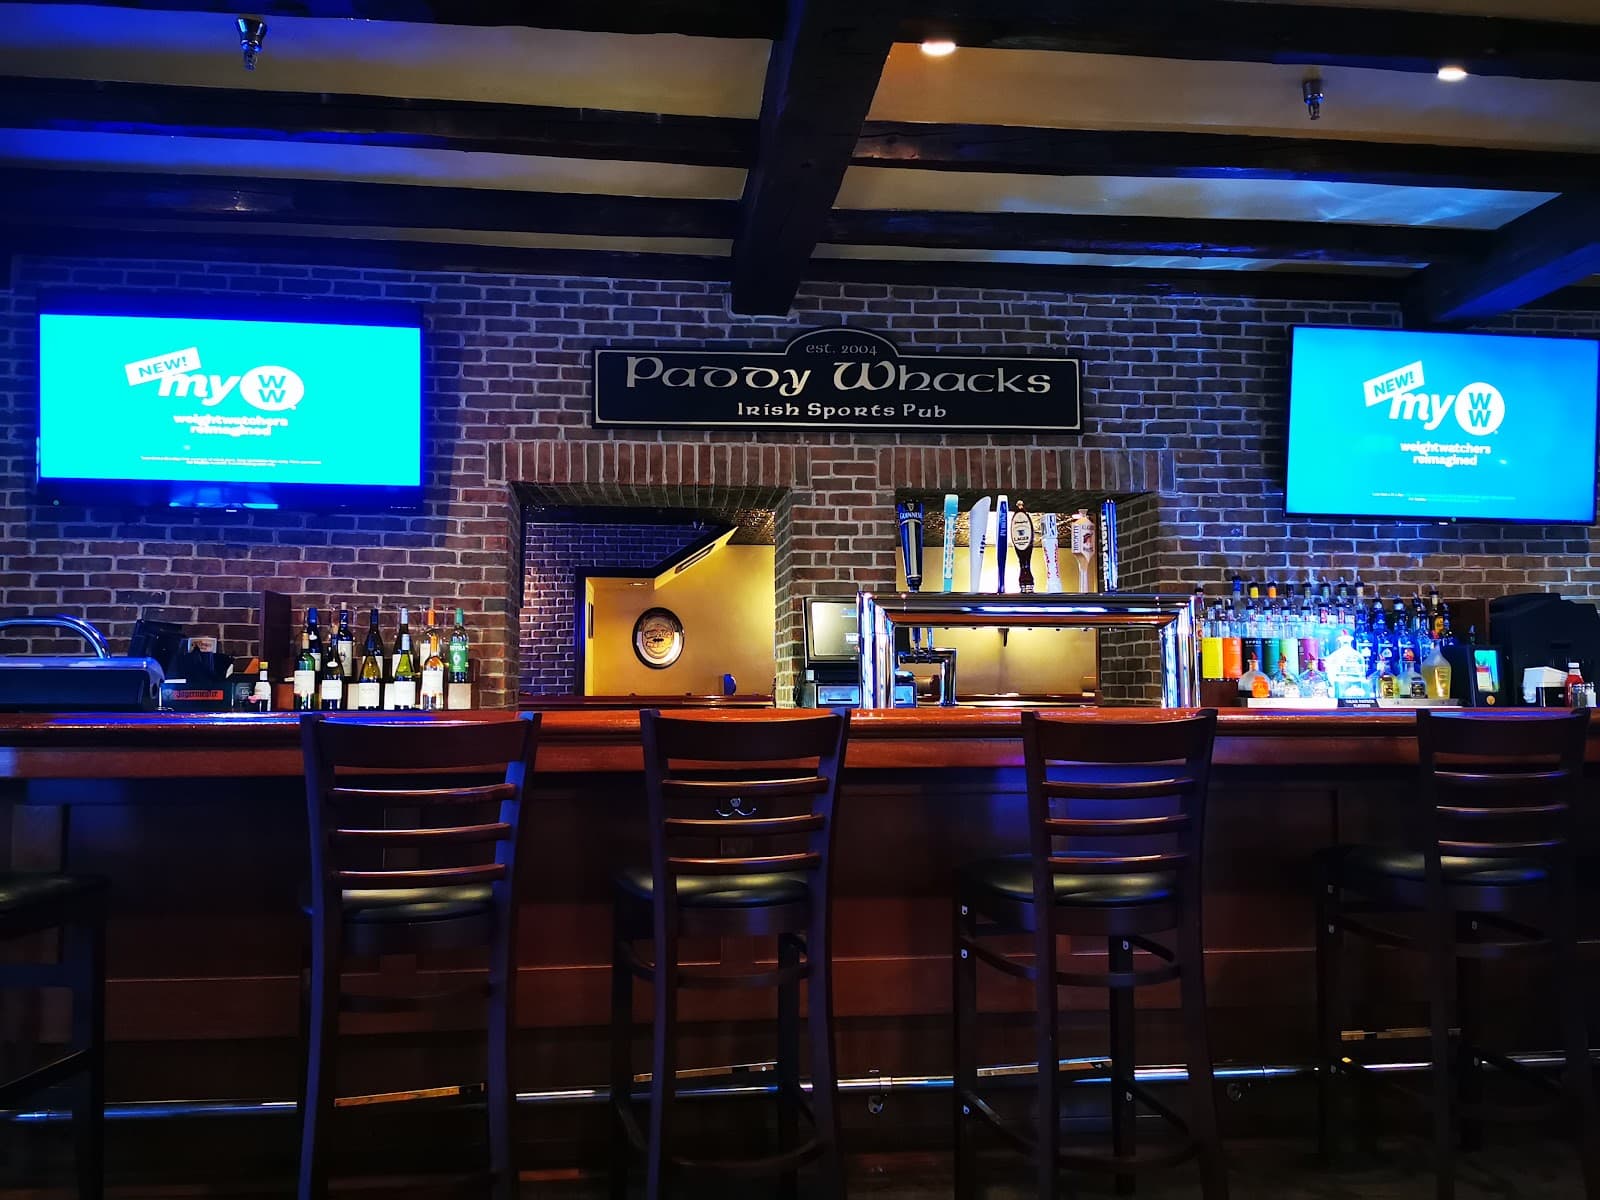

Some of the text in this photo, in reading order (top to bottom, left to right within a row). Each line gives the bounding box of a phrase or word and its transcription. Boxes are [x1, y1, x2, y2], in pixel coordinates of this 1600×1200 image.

[806, 343, 878, 356] est. 2004
[138, 356, 188, 377] NEW!
[626, 356, 1051, 397] Paddy Whacks
[158, 373, 241, 406] my
[1373, 371, 1415, 397] NEW!
[738, 402, 947, 419] Irish Sports Pub
[1388, 392, 1456, 431] my
